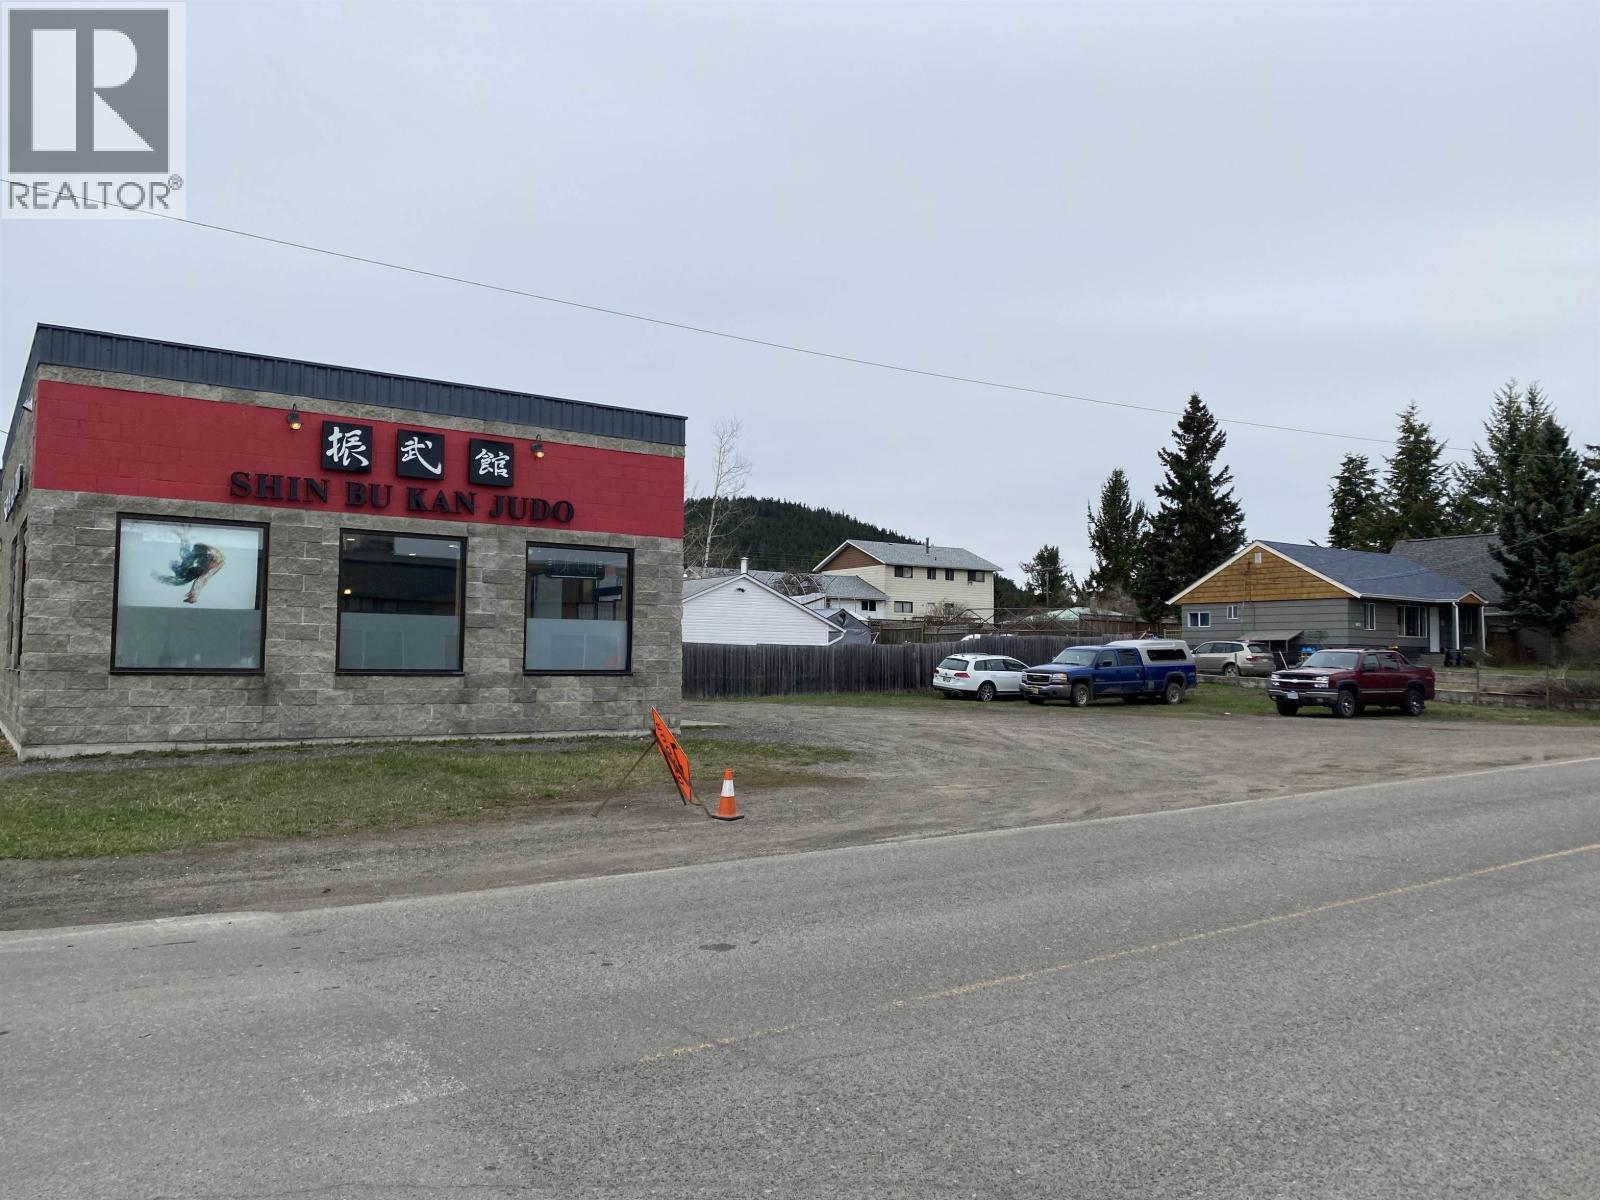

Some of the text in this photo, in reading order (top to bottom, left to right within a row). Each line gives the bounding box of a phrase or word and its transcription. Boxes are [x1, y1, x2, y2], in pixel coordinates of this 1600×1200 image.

[230, 472, 575, 524] SHIN BU KAN JUDO
